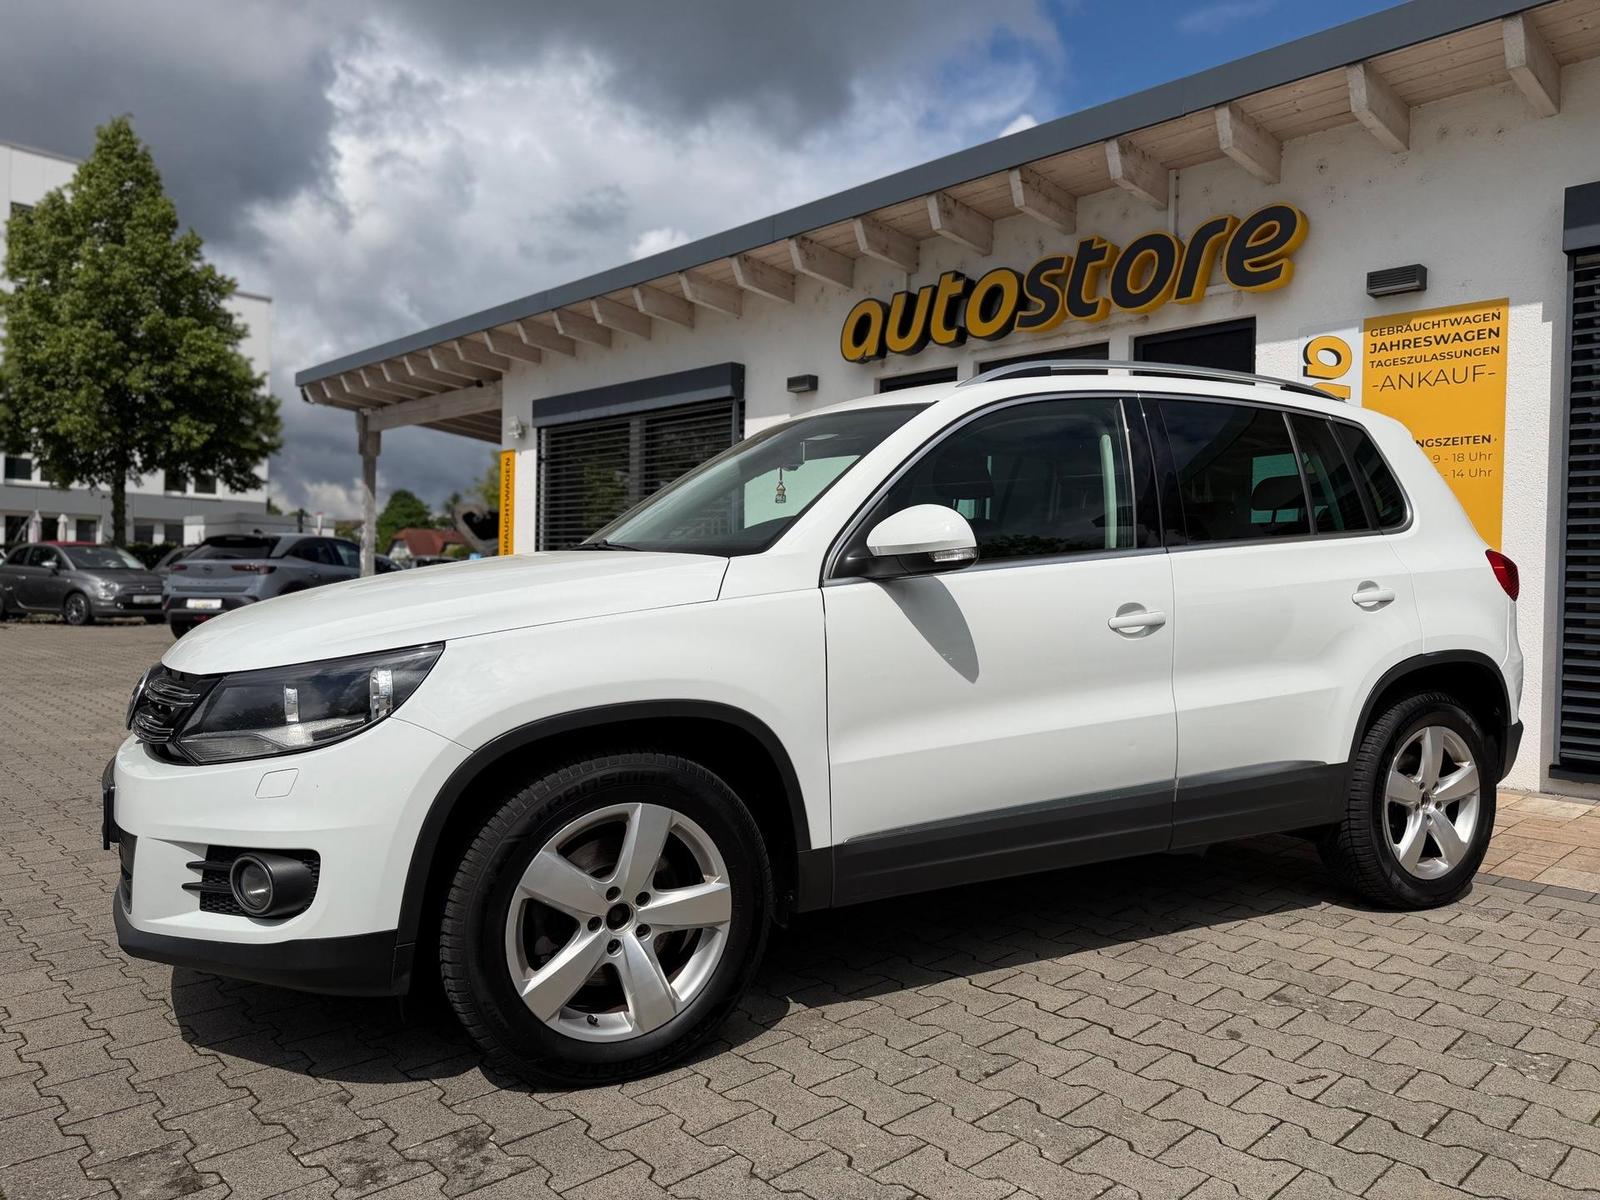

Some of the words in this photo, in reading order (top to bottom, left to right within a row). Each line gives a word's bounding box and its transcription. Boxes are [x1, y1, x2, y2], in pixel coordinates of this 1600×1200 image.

[840, 202, 1309, 364] autostore
[1370, 311, 1501, 338] GEBRAUCHTWAGEN
[1369, 326, 1501, 354] JAHRESWAGEN
[1369, 345, 1501, 369] TAGESZULASSUNGEN
[1371, 363, 1496, 392] -ANKAUF-
[1432, 454, 1441, 464] 9
[1452, 452, 1465, 462] 18
[1468, 451, 1493, 462] Uhr
[1451, 468, 1465, 478] 14
[1468, 467, 1493, 478] Uhr
